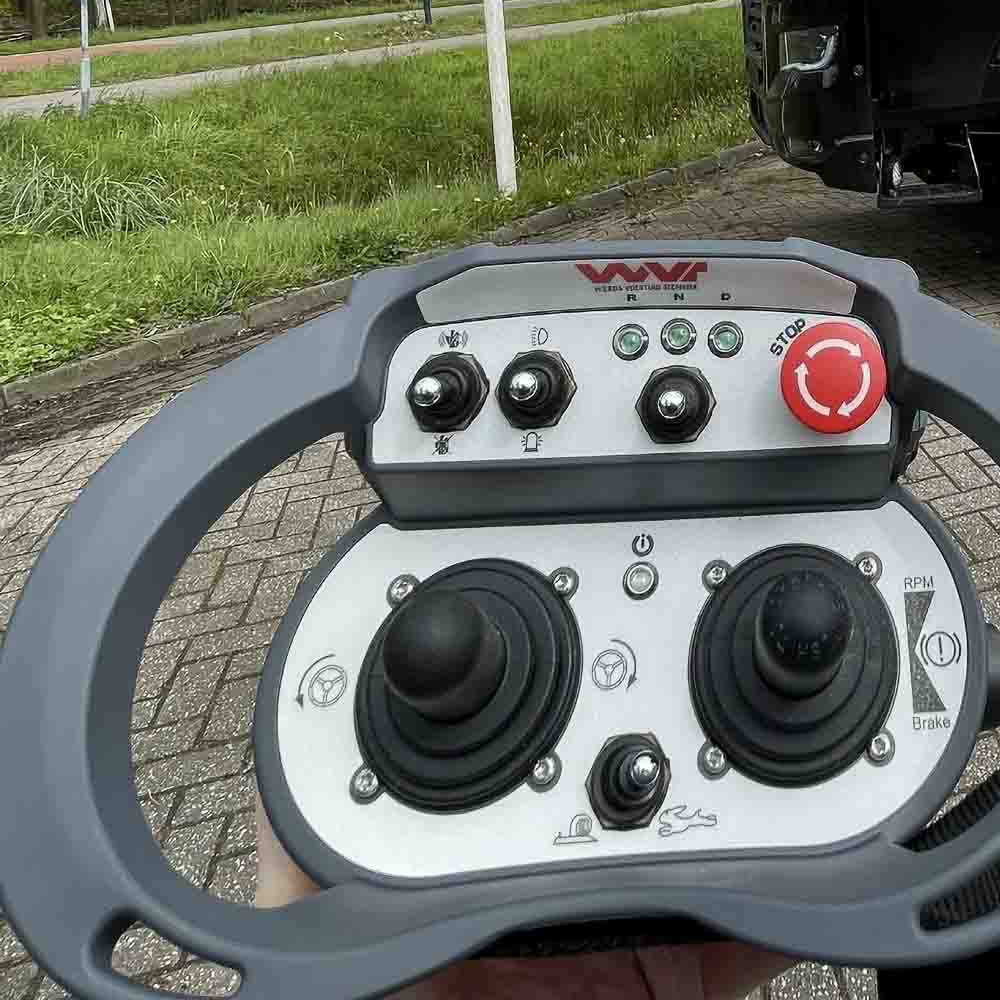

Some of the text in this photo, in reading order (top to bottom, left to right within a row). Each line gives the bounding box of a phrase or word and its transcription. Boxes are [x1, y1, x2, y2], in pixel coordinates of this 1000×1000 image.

[769, 318, 806, 356] STOP
[904, 576, 933, 590] RPM
[912, 716, 950, 730] Brake
